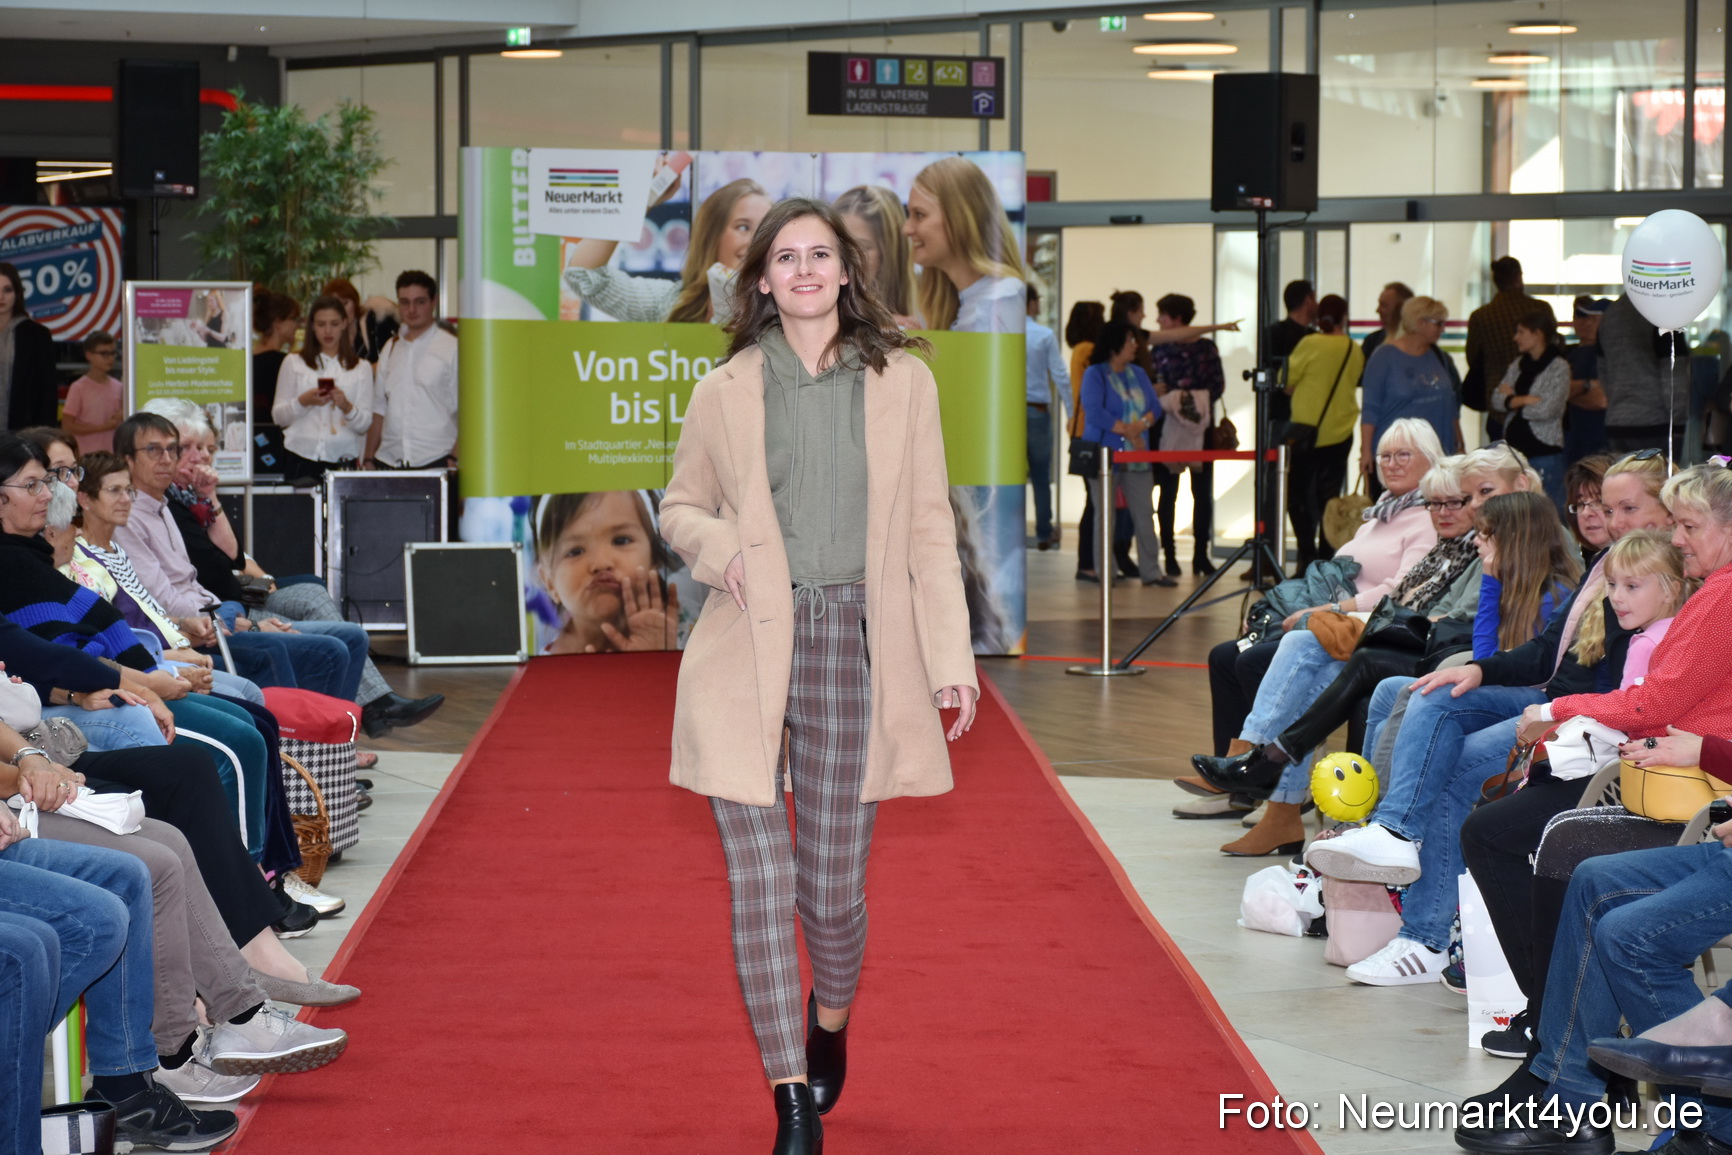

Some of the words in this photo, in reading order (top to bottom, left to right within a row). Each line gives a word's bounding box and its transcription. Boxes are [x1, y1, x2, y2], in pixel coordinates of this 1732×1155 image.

[846, 88, 857, 98] IN
[859, 88, 877, 99] DER
[880, 89, 929, 101] UNTEREN
[846, 102, 929, 115] LADENSTRASSE
[545, 190, 624, 204] NeuerMarkt
[548, 207, 563, 215] Alles
[603, 207, 620, 215] Dach.
[0, 223, 97, 251] ALABVERKAUF
[1627, 274, 1696, 290] NeuerMarkt
[573, 350, 639, 382] Von
[610, 391, 661, 425] bis
[669, 392, 687, 424] L
[565, 440, 577, 450] Im
[577, 439, 643, 452] Stadtquartier
[588, 453, 655, 466] Multiplexkino
